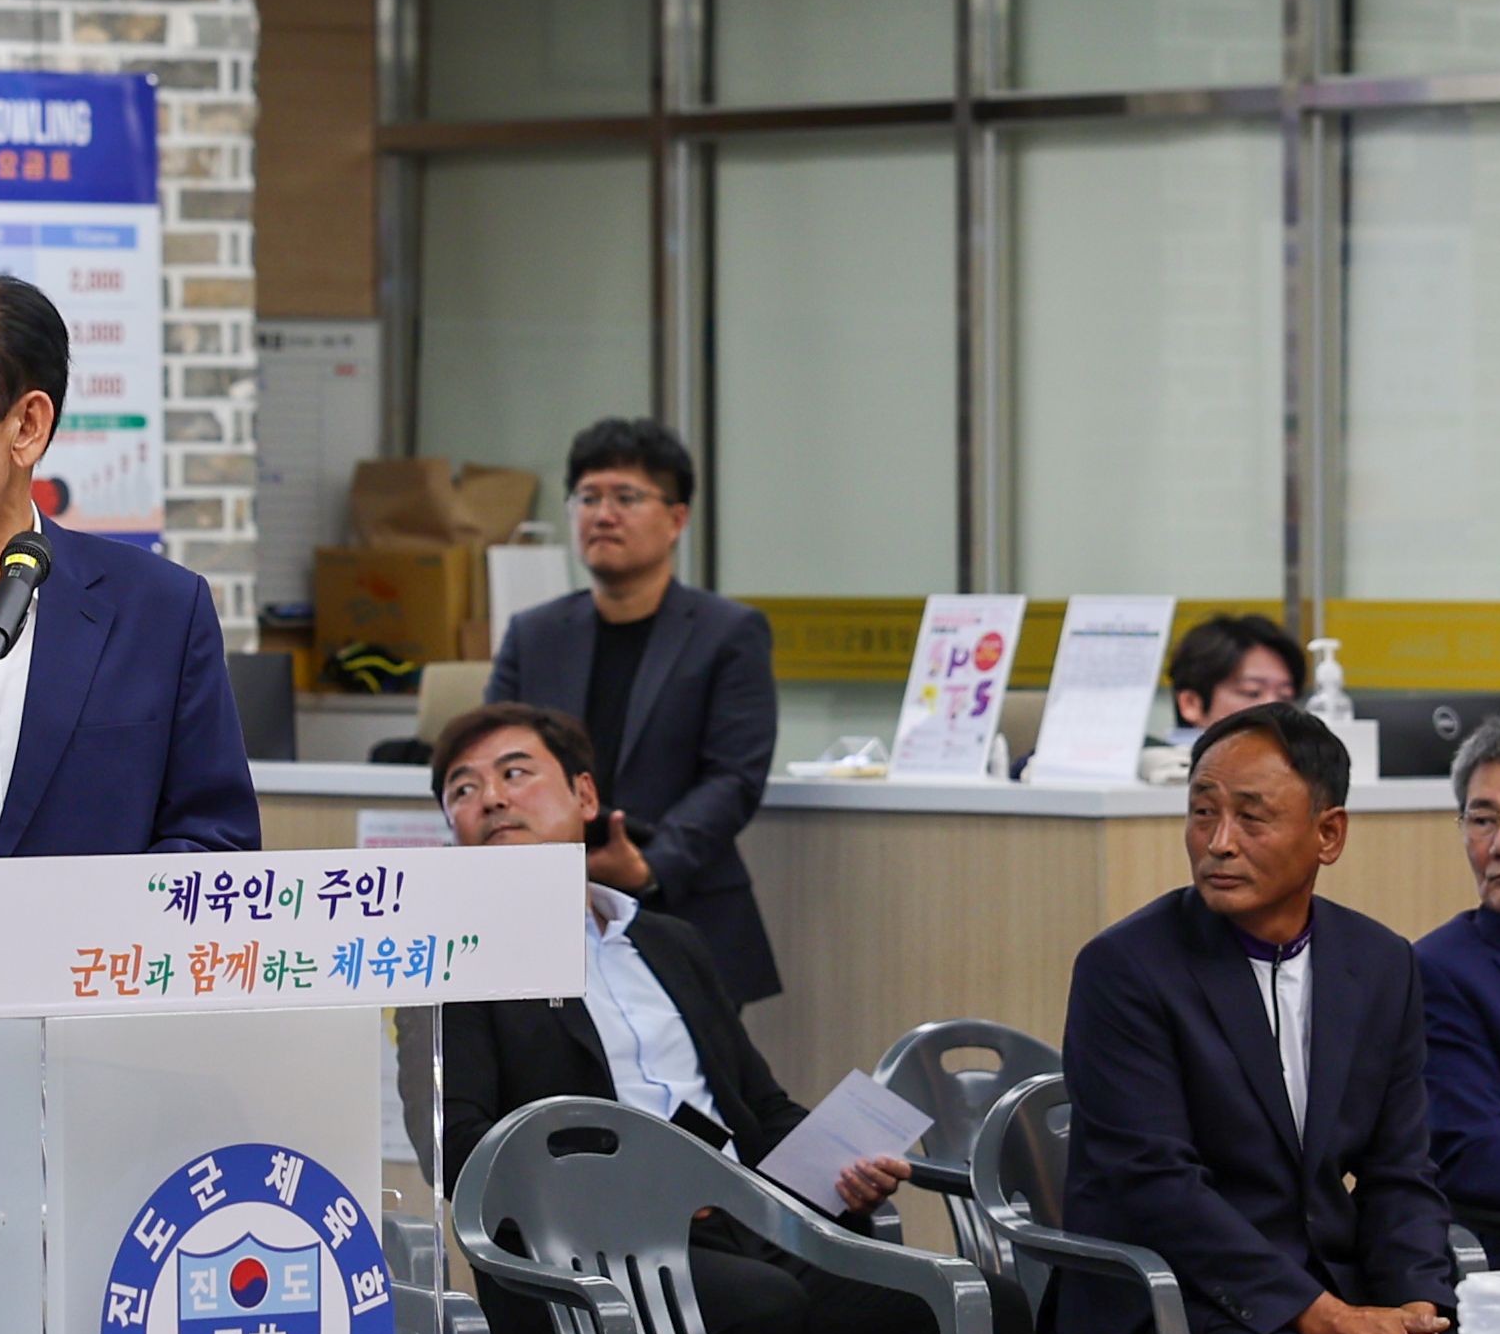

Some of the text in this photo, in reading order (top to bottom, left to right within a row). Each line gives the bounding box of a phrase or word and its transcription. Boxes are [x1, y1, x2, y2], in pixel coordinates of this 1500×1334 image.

[147, 865, 406, 926] “체육인이 주인!
[69, 934, 480, 998] 군민과 함께하는 체육회!”
[107, 1151, 390, 1328] 진도군체육회
